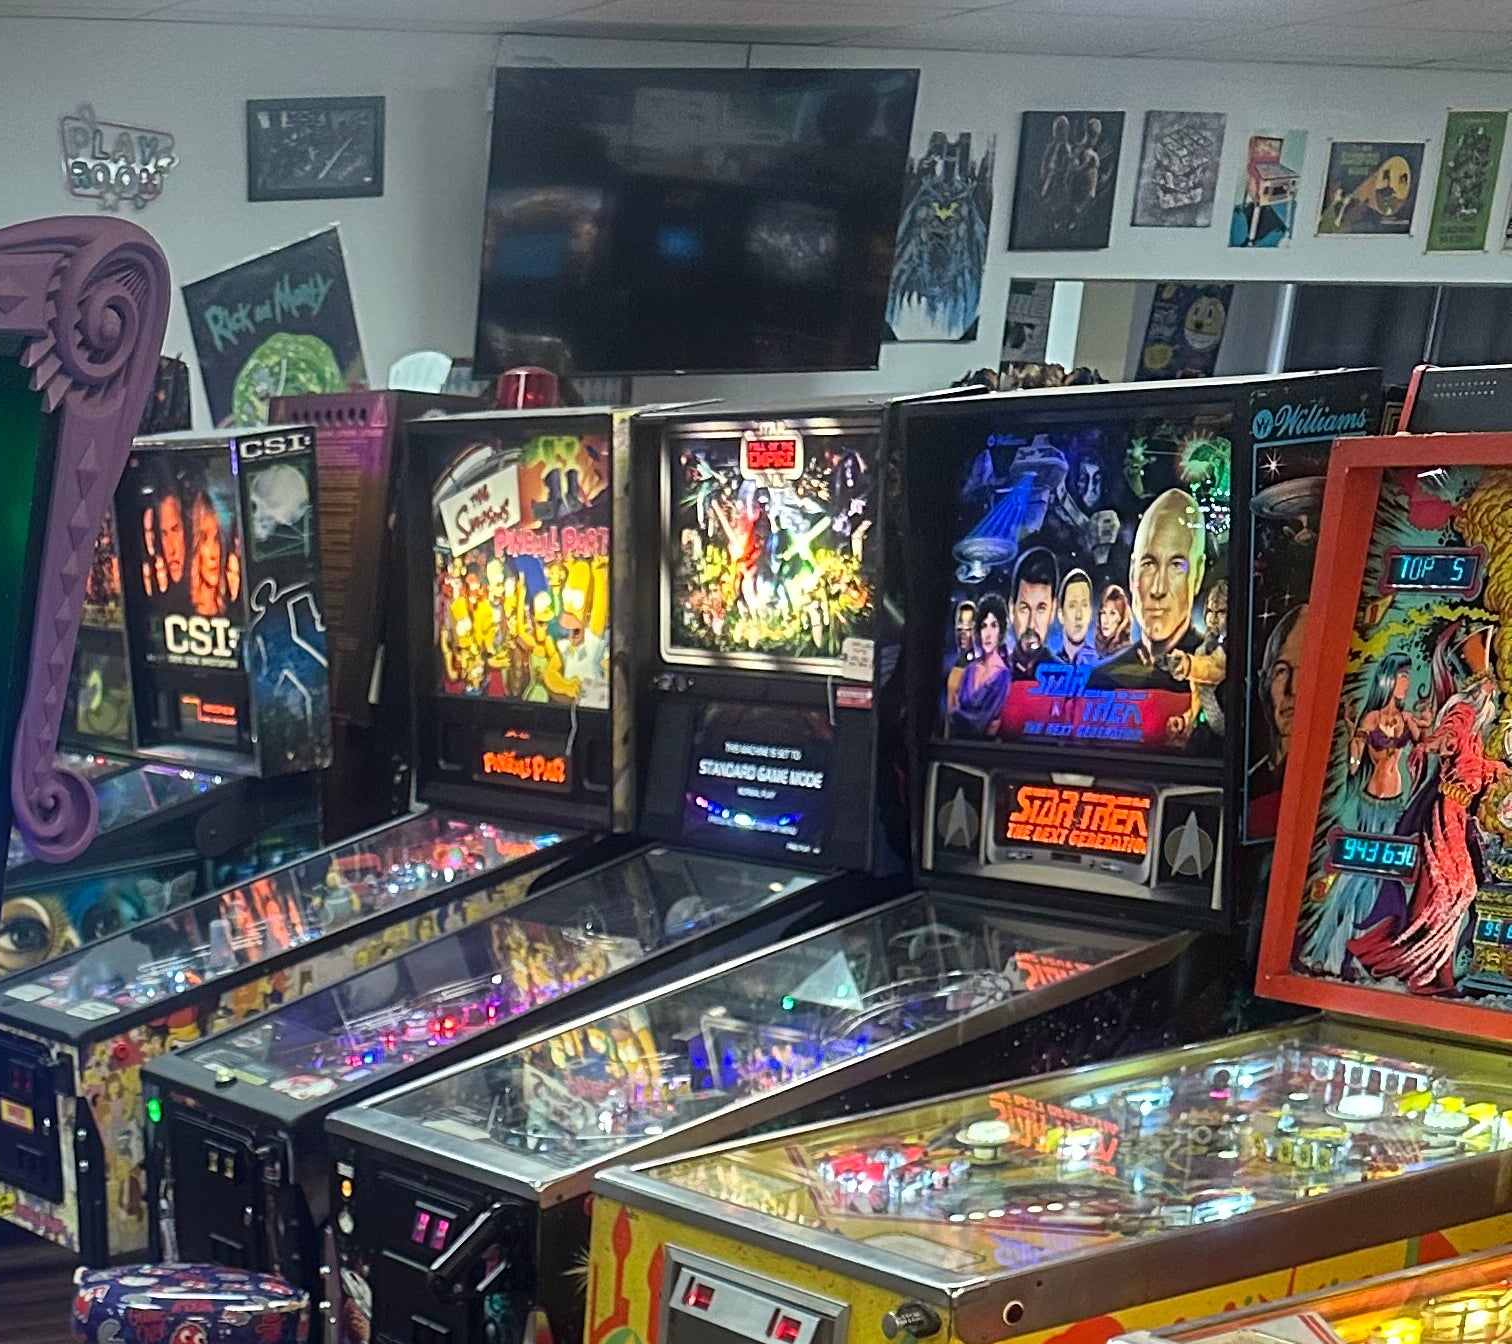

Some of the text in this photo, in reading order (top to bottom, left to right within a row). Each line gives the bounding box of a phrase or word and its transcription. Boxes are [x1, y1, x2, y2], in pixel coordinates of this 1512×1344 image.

[1273, 404, 1368, 437] Williams
[239, 434, 312, 459] CSI:
[1027, 663, 1092, 698] STAR
[1082, 689, 1147, 724] TREK
[698, 758, 824, 789] STANDARD GAME MODE
[1009, 786, 1151, 837] STAR TREK
[1006, 822, 1034, 841] THE
[1032, 825, 1069, 845] NEXT
